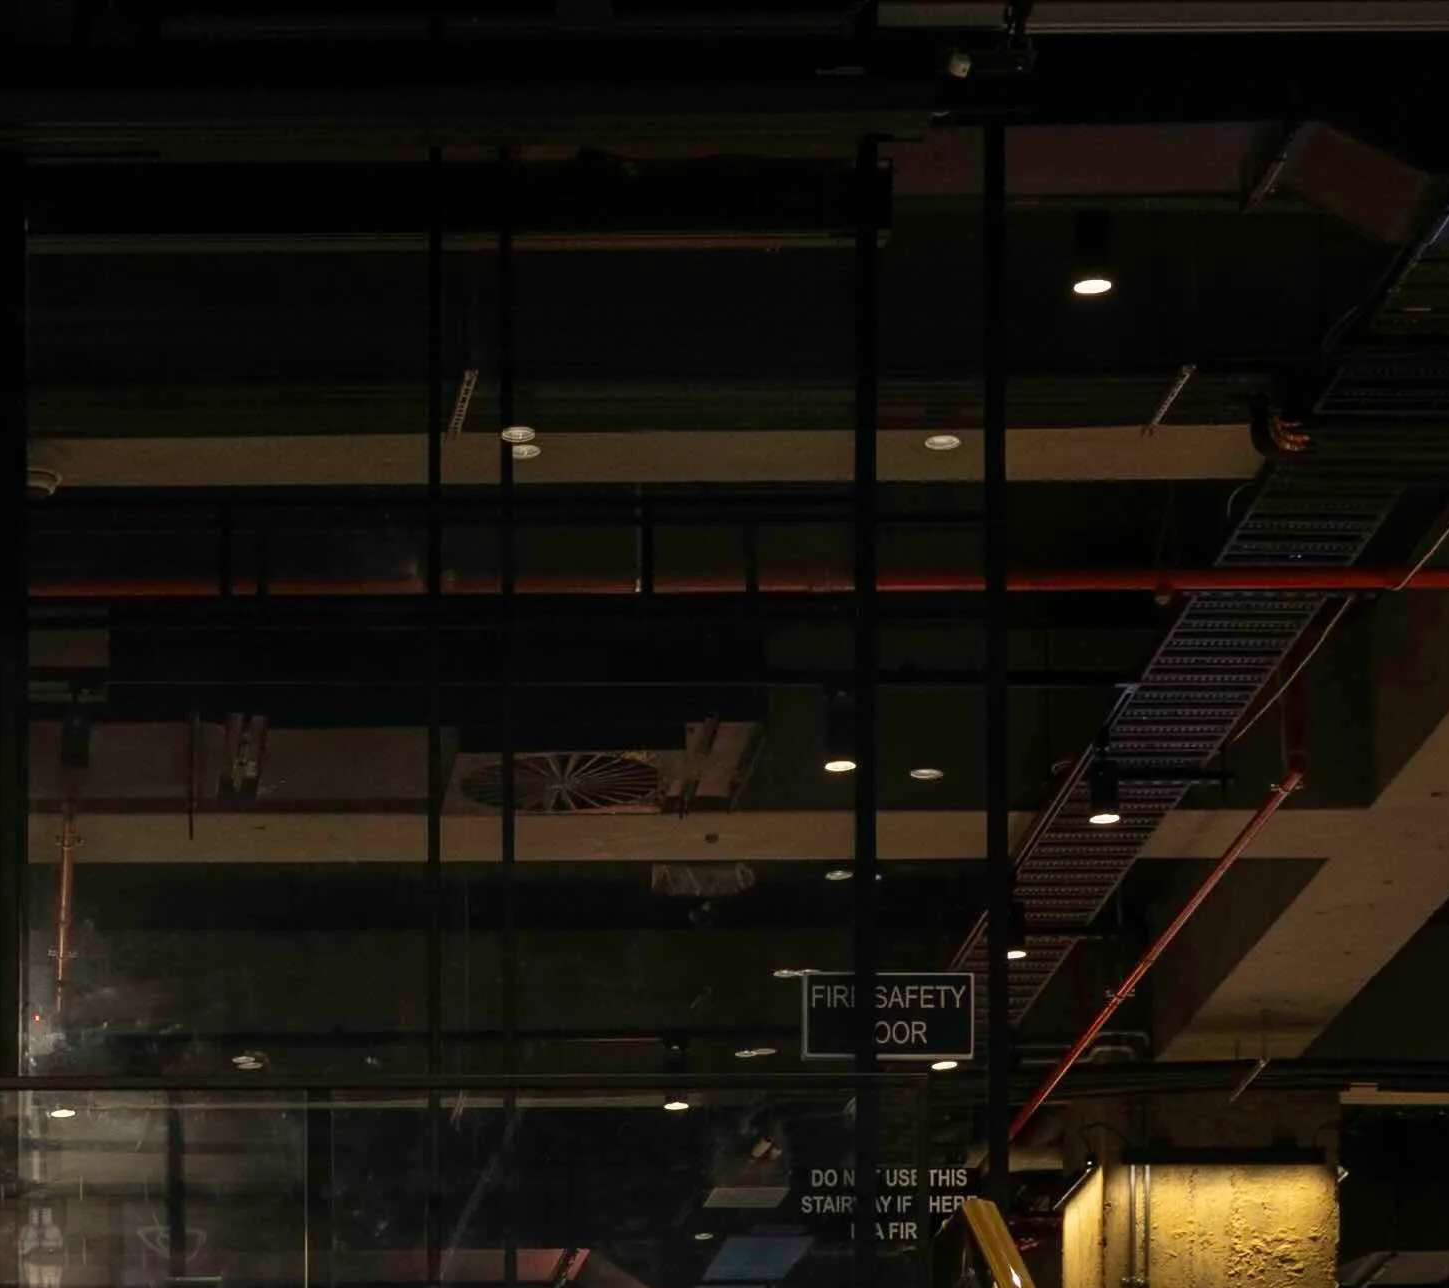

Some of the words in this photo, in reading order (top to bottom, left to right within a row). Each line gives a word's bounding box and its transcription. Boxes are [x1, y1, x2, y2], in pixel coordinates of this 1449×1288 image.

[811, 985, 856, 1009] FIR
[875, 985, 967, 1009] SAFETY
[875, 1021, 928, 1045] OOR
[811, 1168, 838, 1188] DO
[928, 1168, 968, 1188] THIS
[896, 1195, 913, 1214] IF
[888, 1222, 919, 1240] FIR
